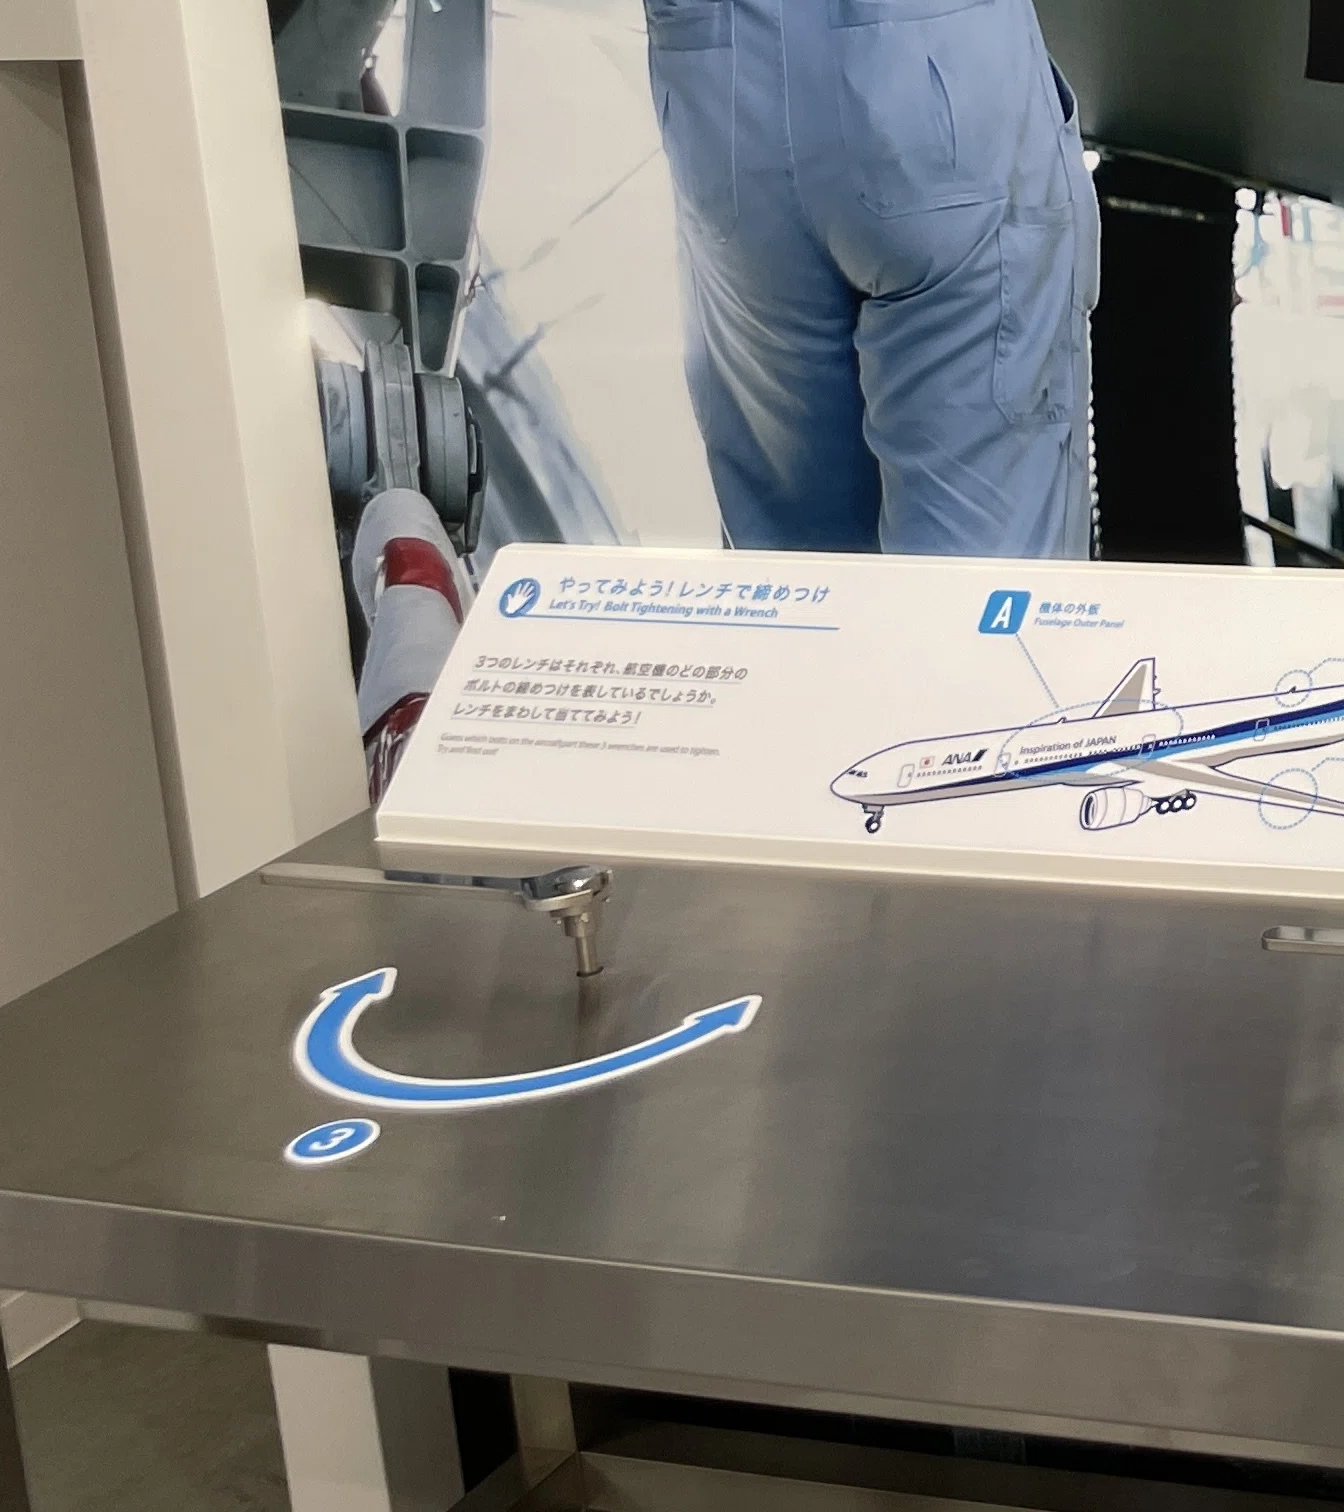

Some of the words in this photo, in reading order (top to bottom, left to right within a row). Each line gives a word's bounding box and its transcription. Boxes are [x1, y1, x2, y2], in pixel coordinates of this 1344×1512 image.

[549, 600, 575, 611] Let's
[578, 601, 601, 614] Try!
[603, 602, 629, 613] Bolt
[630, 602, 693, 617] Tightening
[696, 605, 721, 616] with
[723, 607, 731, 616] a
[734, 606, 778, 618] Wrench
[990, 596, 1013, 629] A
[1039, 602, 1101, 615] 機体の外板
[1034, 617, 1072, 628] Fuselage
[1073, 619, 1098, 627] Outer
[1099, 619, 1125, 628] Panel
[1019, 742, 1071, 755] Inspiration
[1073, 739, 1084, 748] of
[1085, 736, 1117, 747] JAPAN
[941, 751, 972, 766] ANA
[311, 1126, 357, 1151] 3
